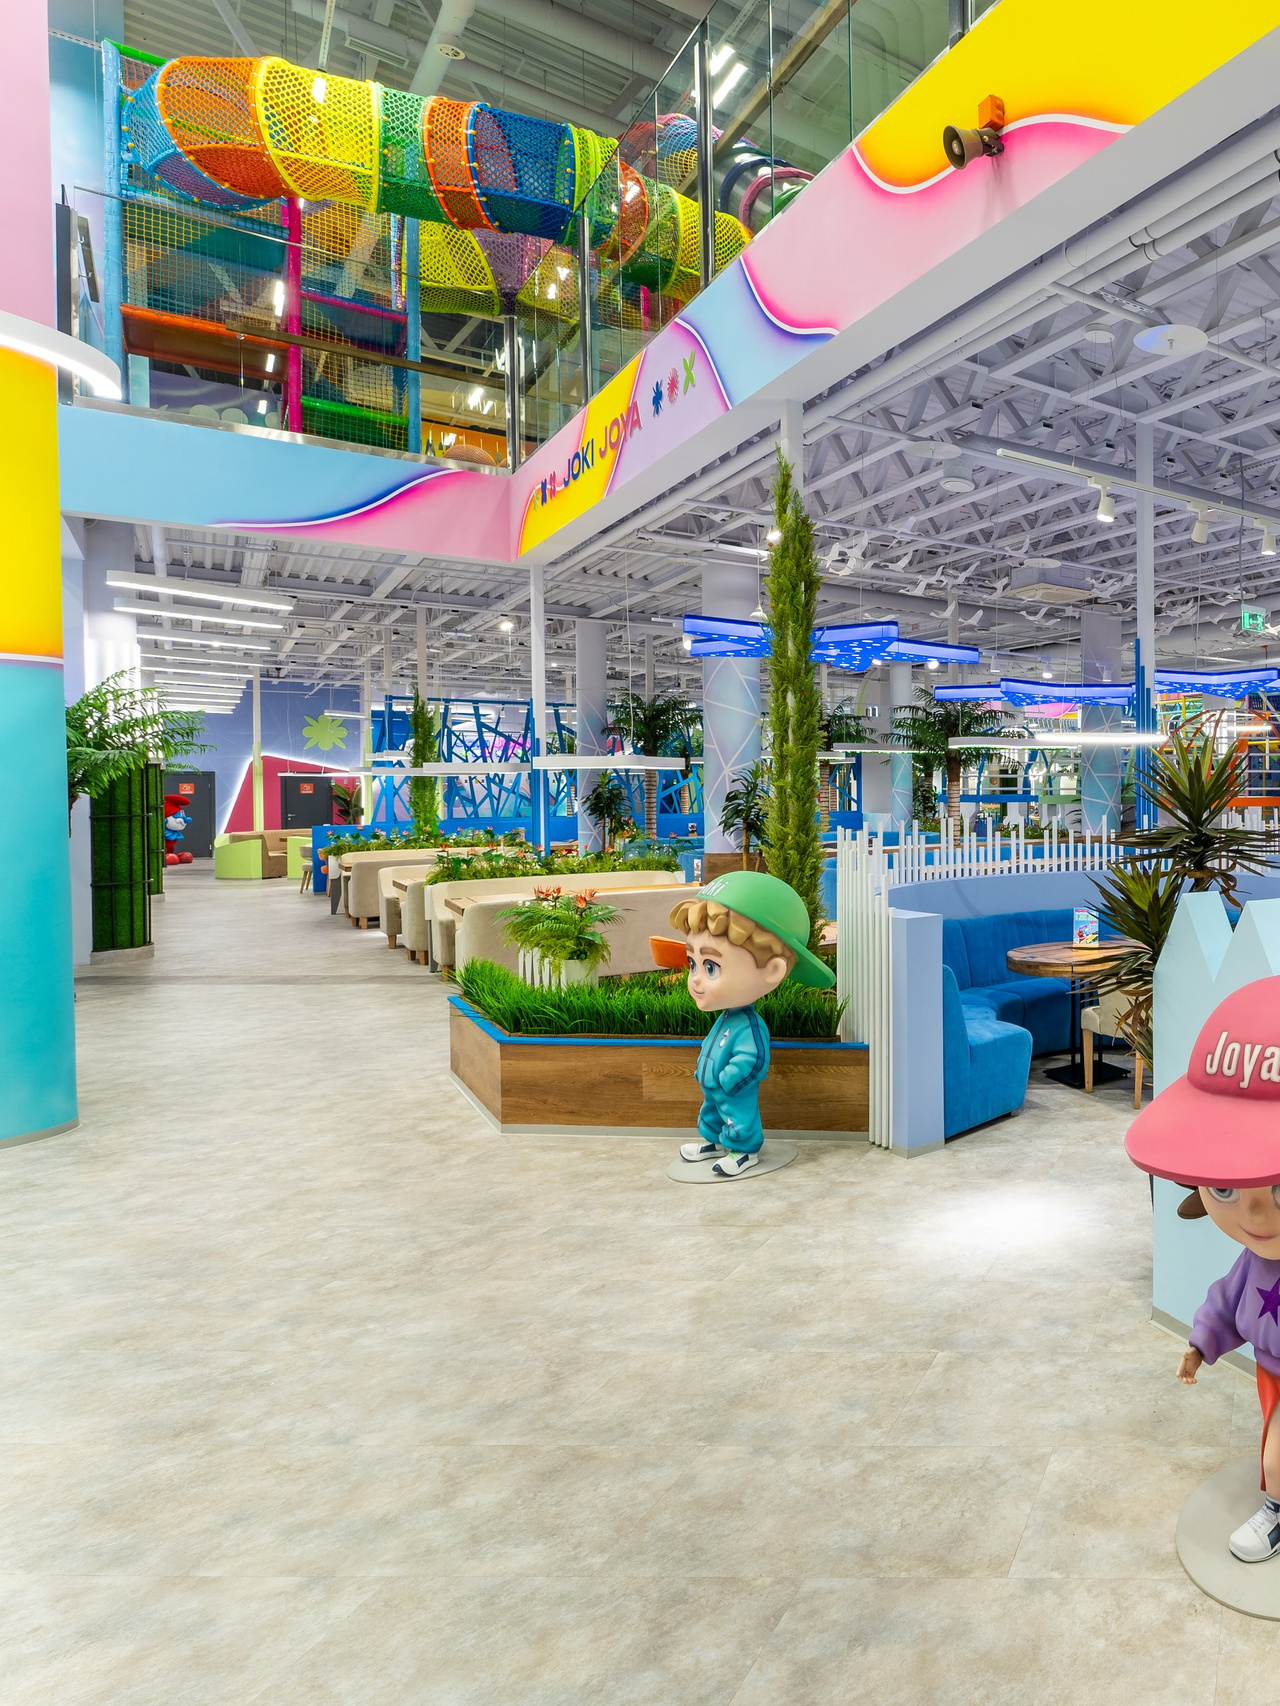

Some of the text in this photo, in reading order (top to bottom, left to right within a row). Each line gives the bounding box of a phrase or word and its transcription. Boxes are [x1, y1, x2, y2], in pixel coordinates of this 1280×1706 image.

[563, 401, 642, 487] JOKI JOYA
[699, 878, 729, 897] oki
